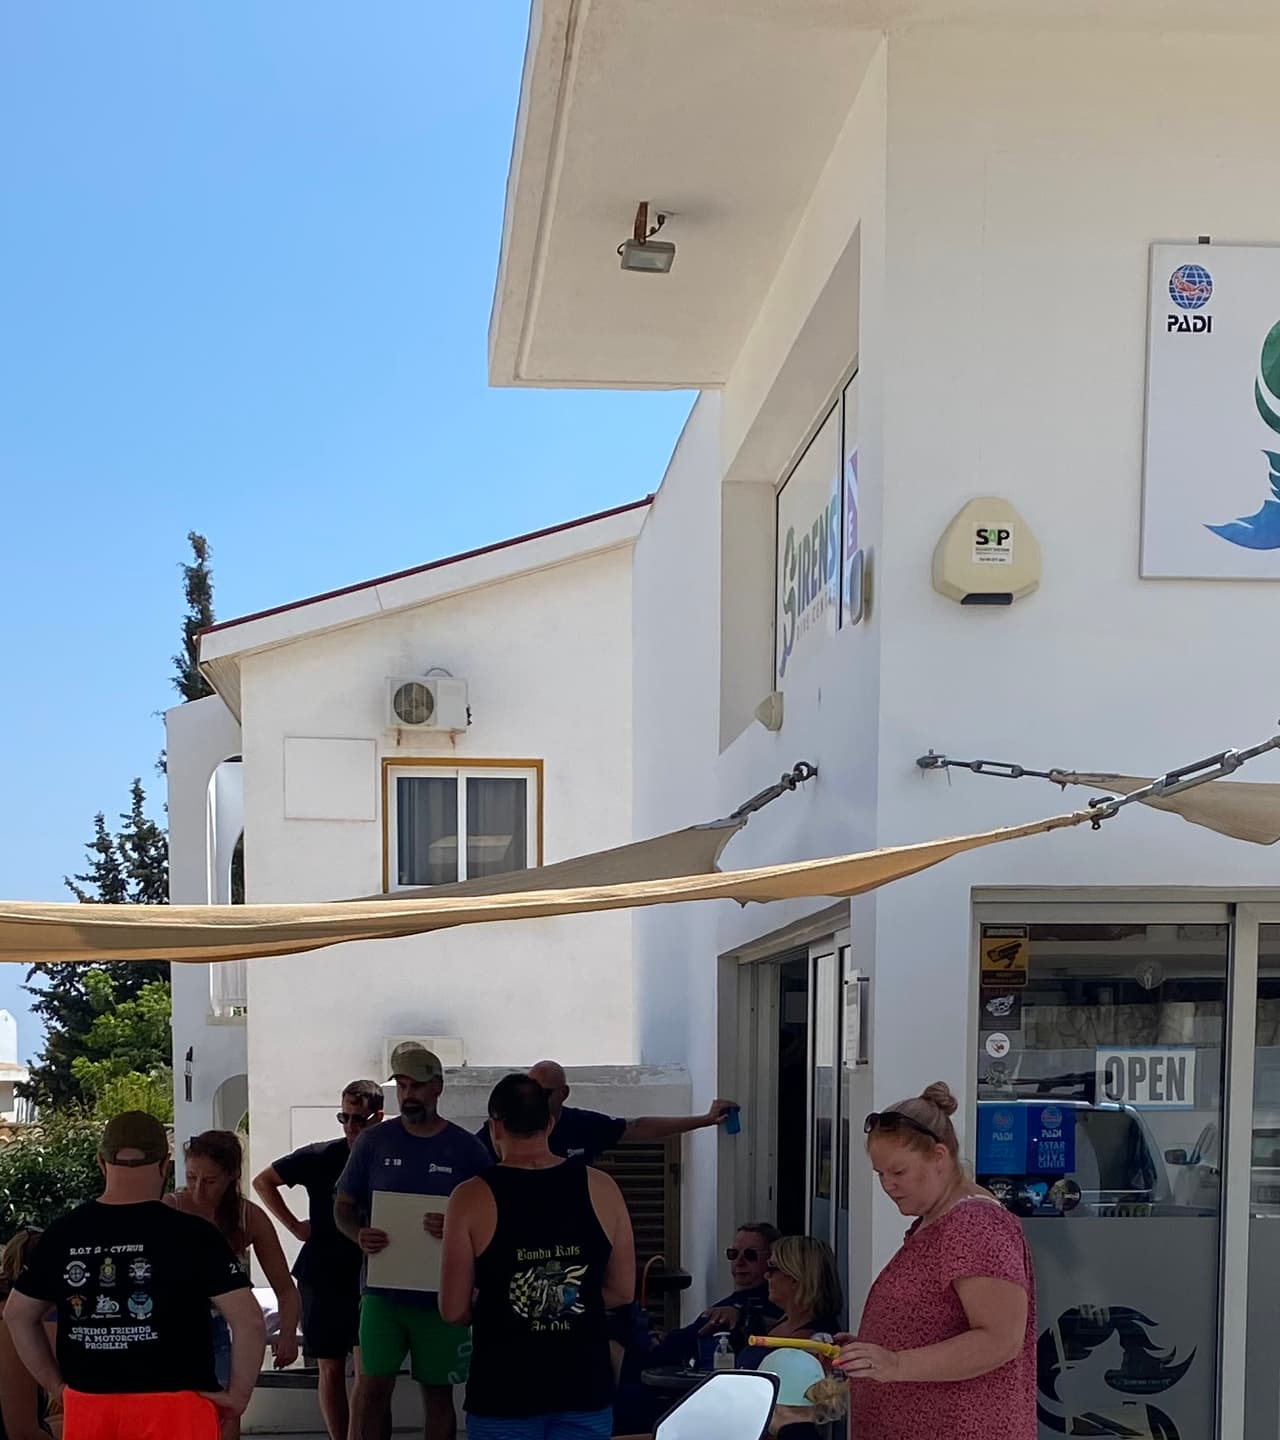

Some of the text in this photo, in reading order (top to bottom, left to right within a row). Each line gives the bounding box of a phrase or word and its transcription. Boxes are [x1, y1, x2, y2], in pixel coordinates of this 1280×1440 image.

[1167, 314, 1212, 333] PADI
[1102, 1055, 1187, 1102] OPEN
[110, 1325, 151, 1335] FRIENDS
[94, 1331, 159, 1342] MOTORCYCLE
[84, 1341, 128, 1350] PROBLEM
